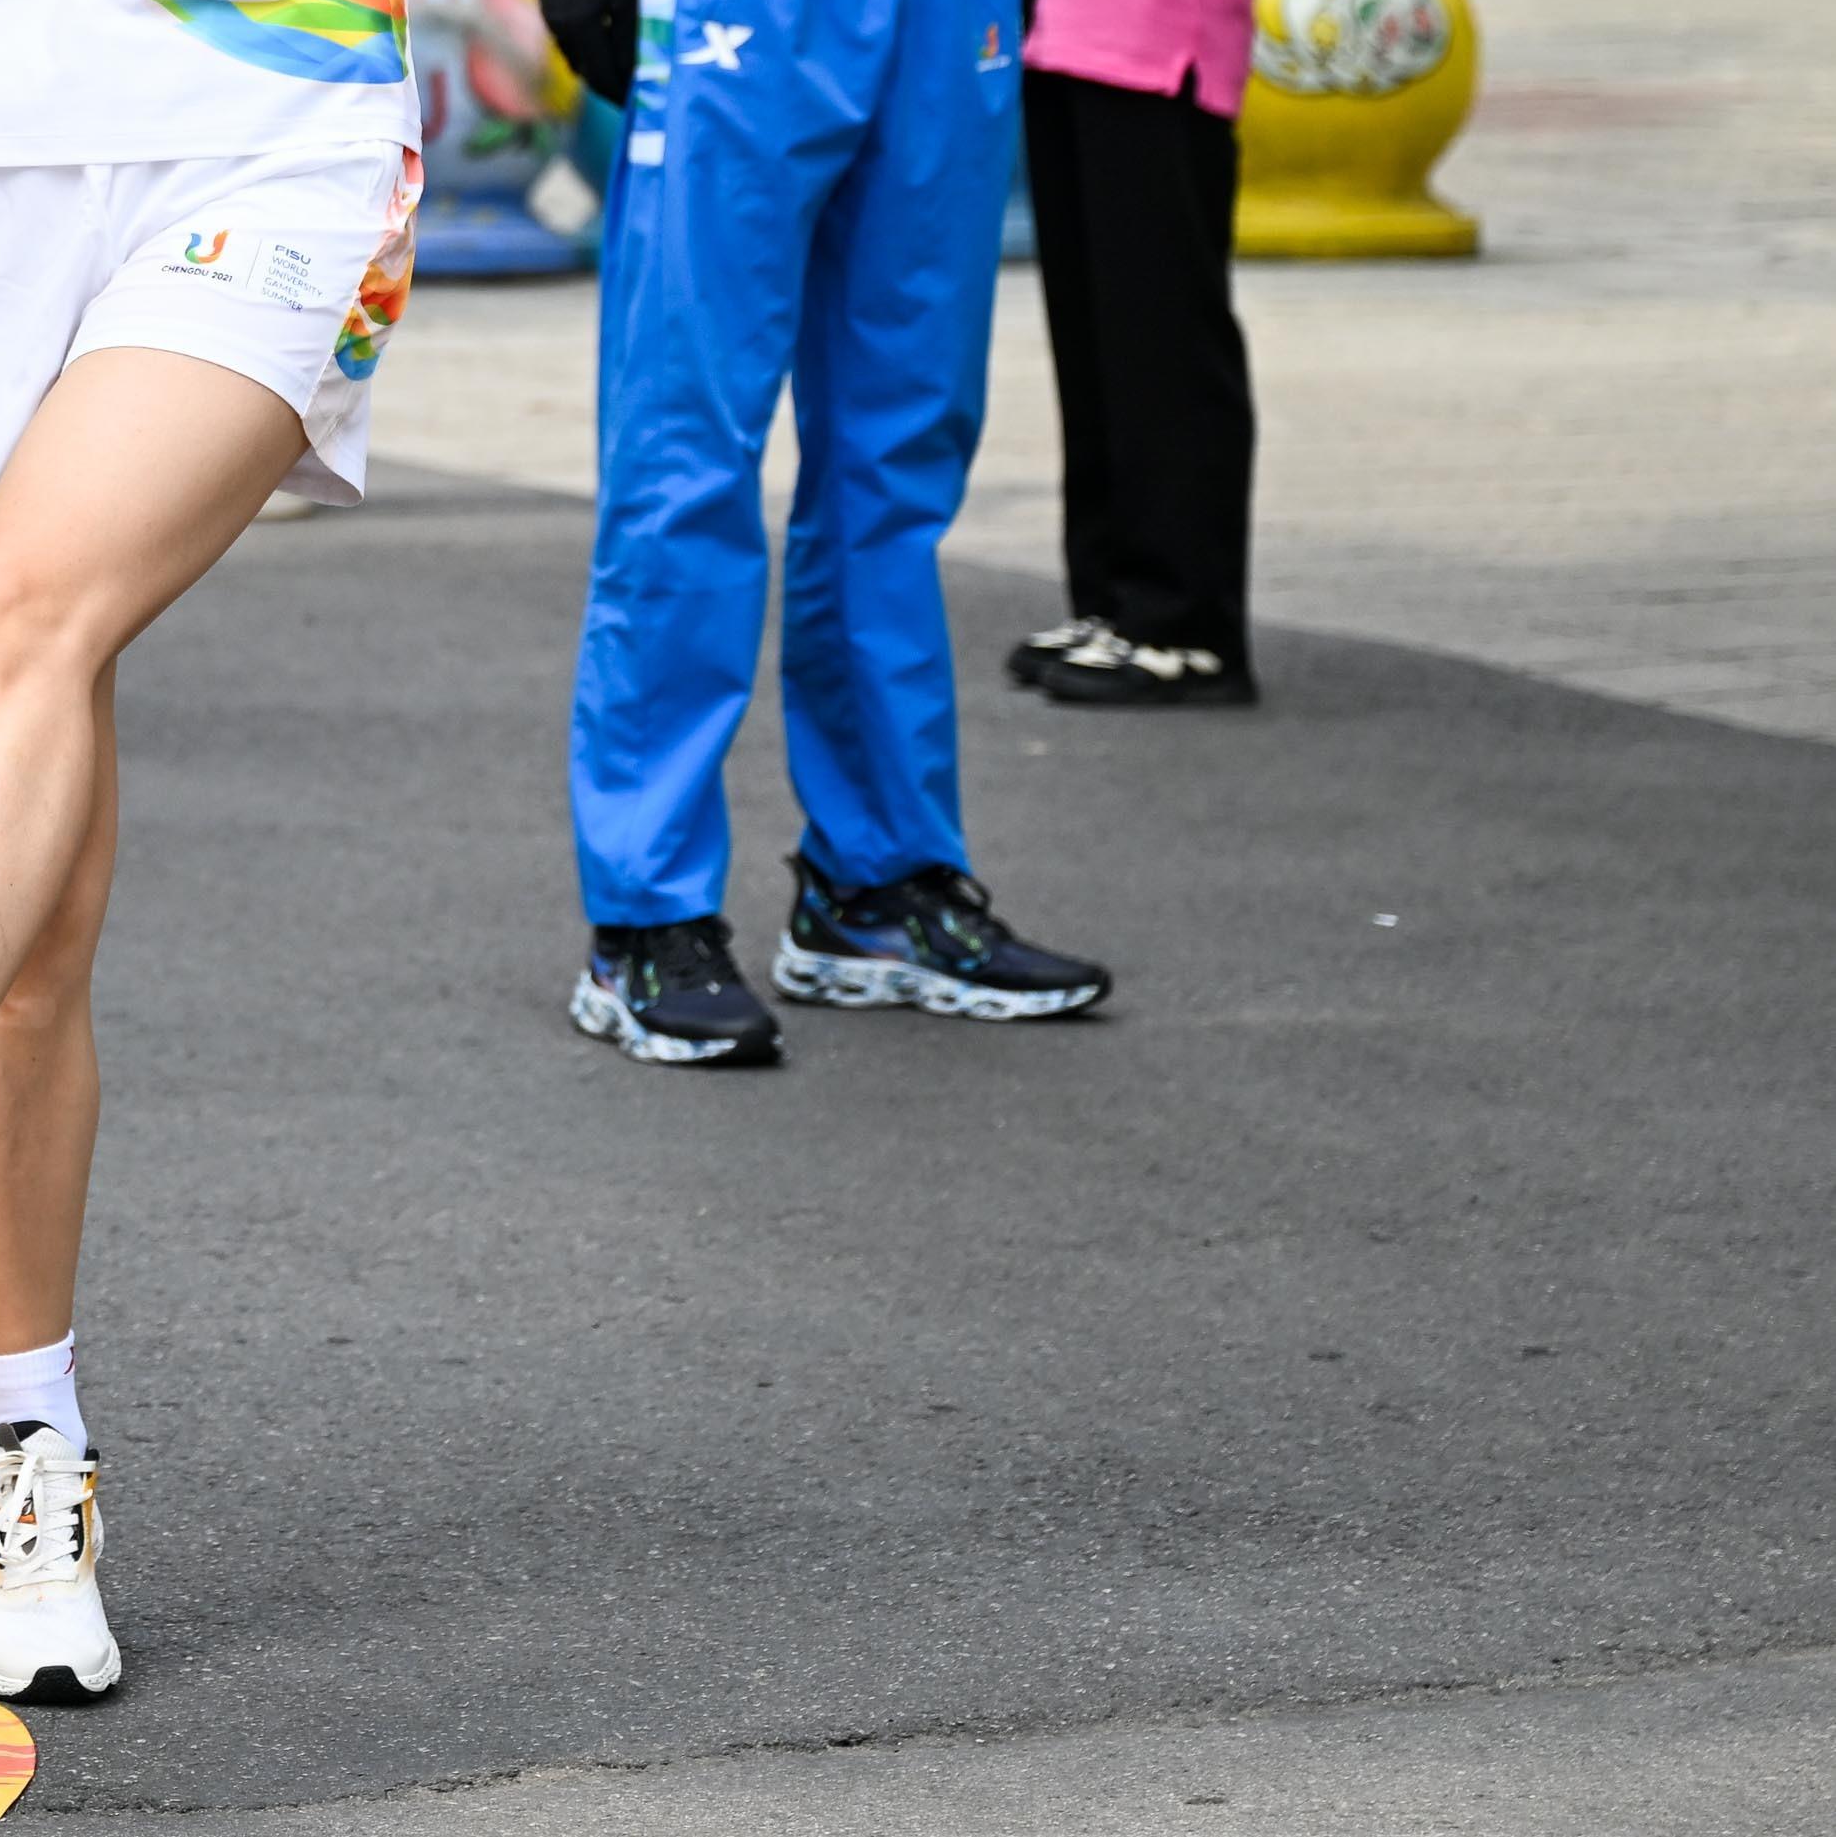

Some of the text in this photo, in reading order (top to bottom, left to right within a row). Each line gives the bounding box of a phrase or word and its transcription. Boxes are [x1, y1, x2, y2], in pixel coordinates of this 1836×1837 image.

[274, 244, 312, 265] FISU
[161, 265, 209, 277] CHENGDU
[272, 255, 309, 278] WORLD
[268, 266, 323, 298] UNIVERSITY
[262, 286, 303, 313] SUMMER
